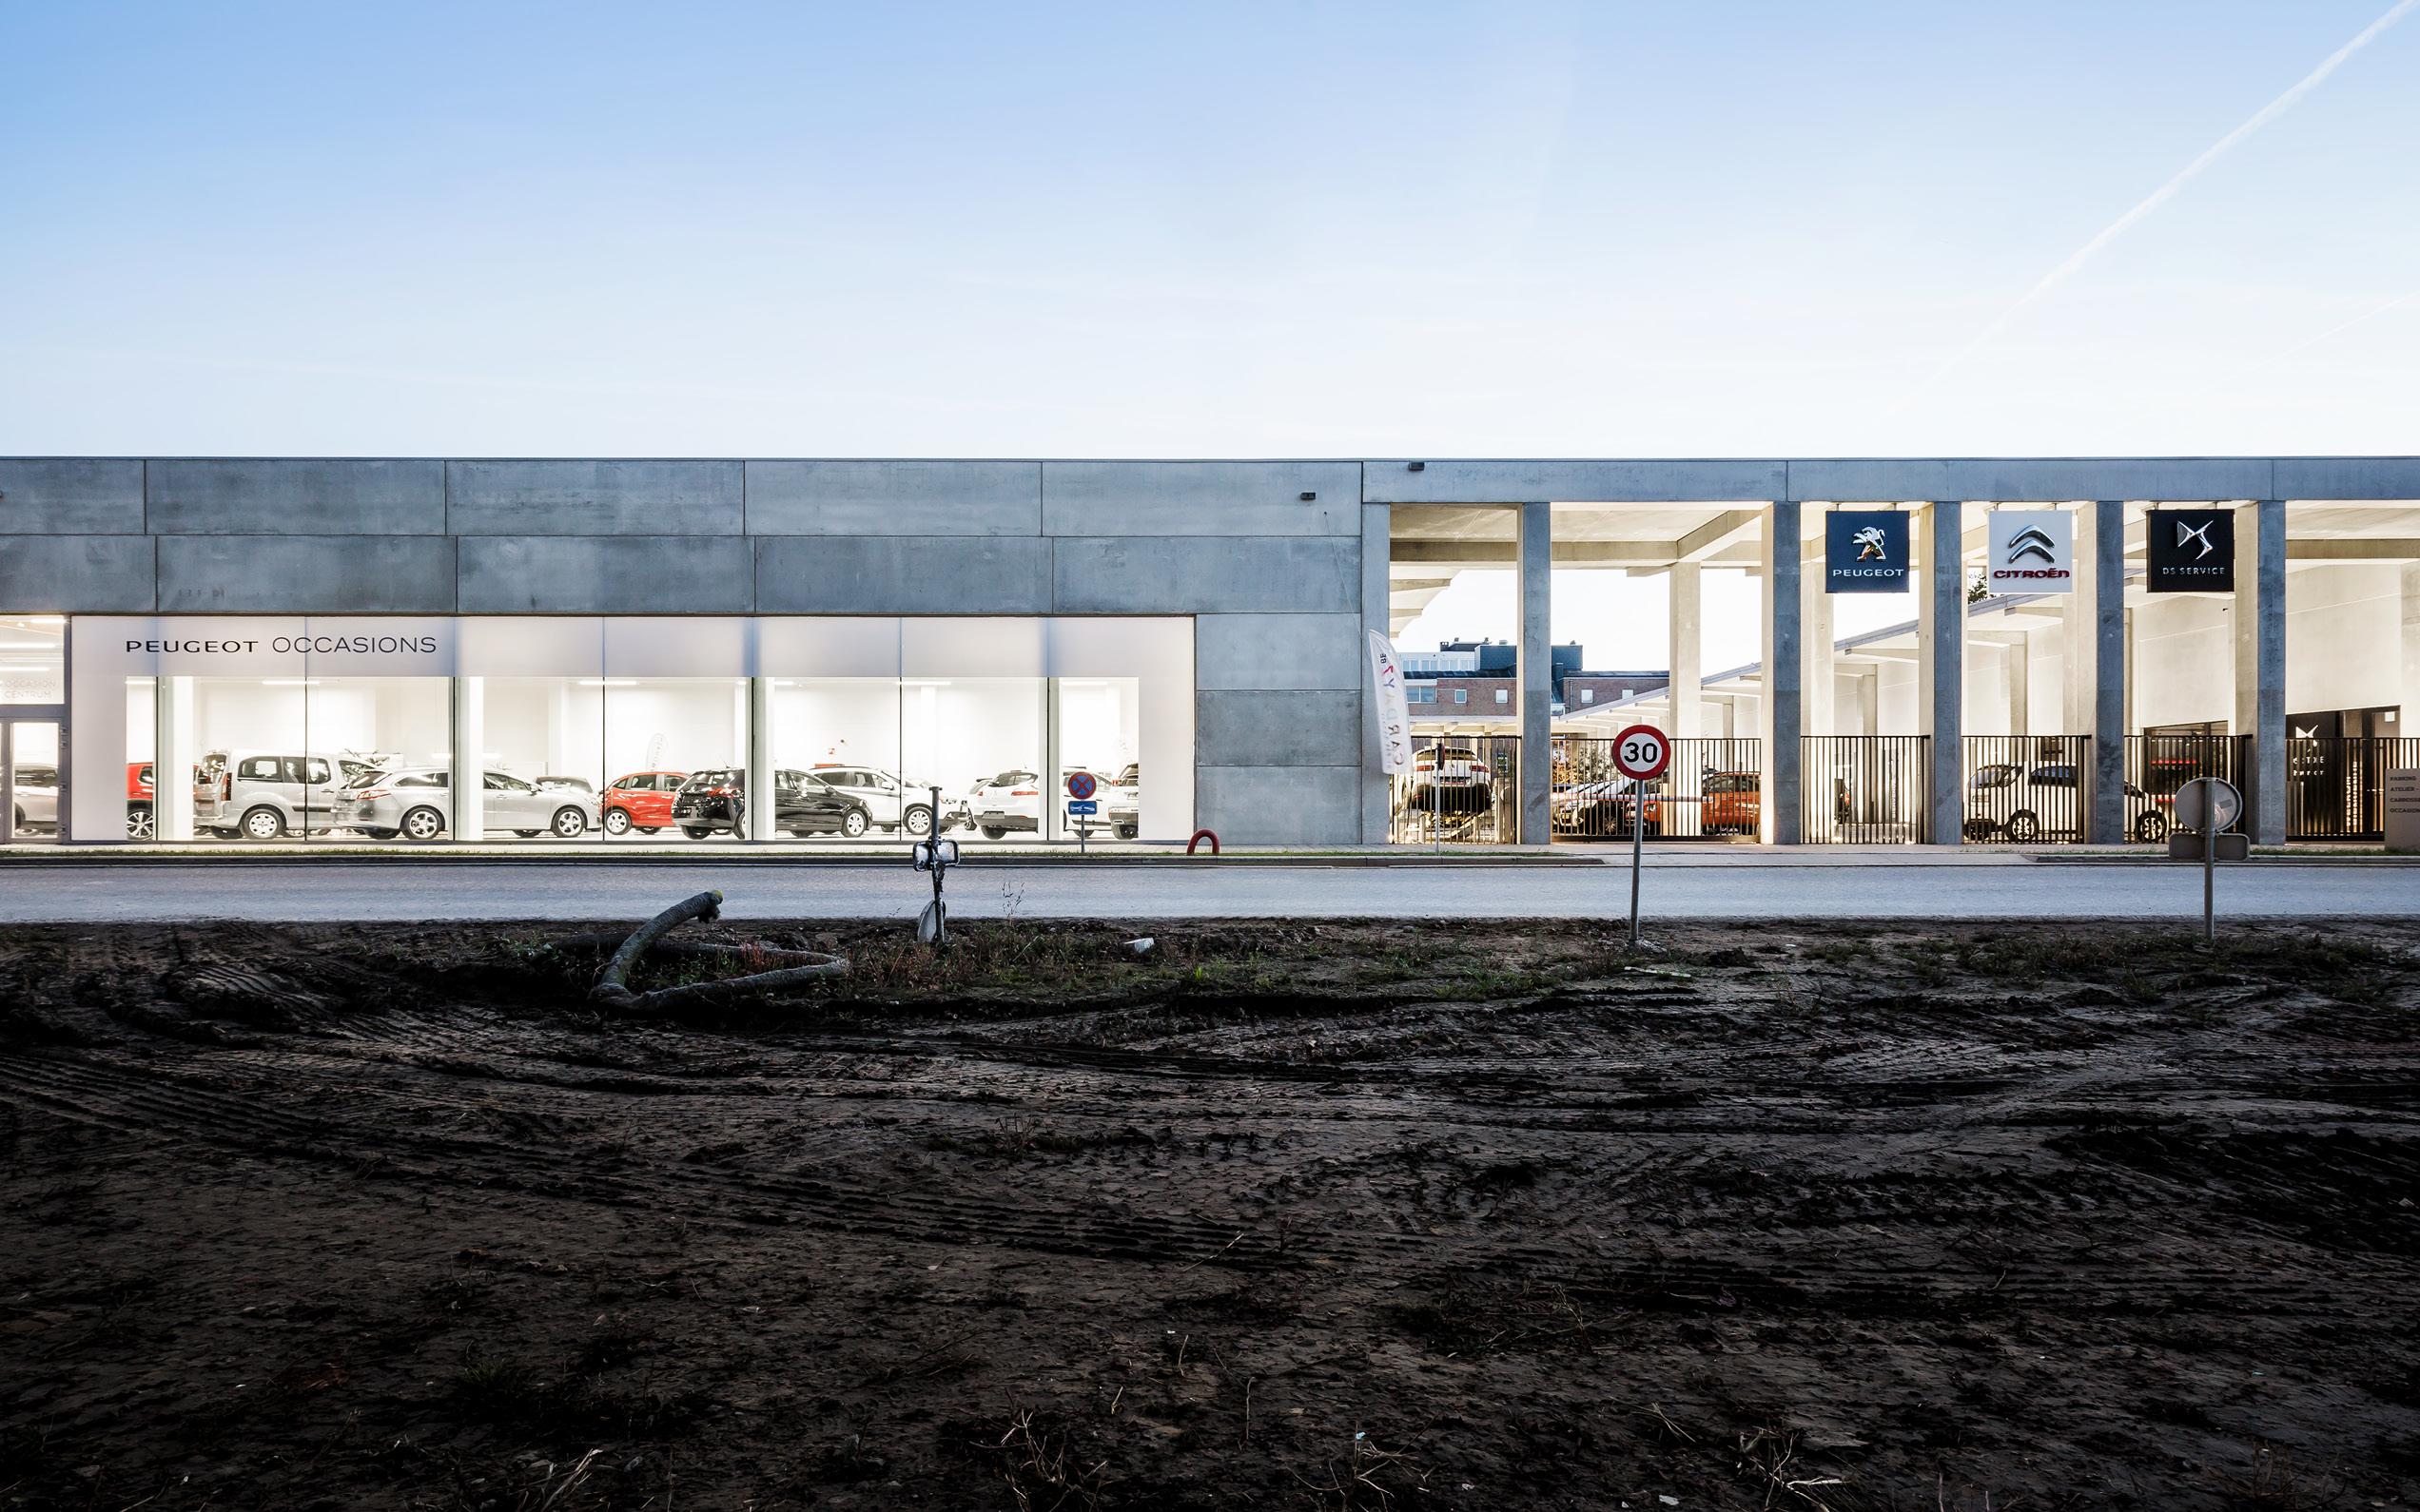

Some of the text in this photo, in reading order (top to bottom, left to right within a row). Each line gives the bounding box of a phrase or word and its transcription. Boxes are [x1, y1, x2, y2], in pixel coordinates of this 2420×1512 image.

[1832, 569, 1904, 577] PEUGEOT
[2162, 567, 2225, 575] DS SERVICE
[126, 636, 437, 653] PEUGEOT OCCASIONS
[1624, 742, 1658, 763] 30
